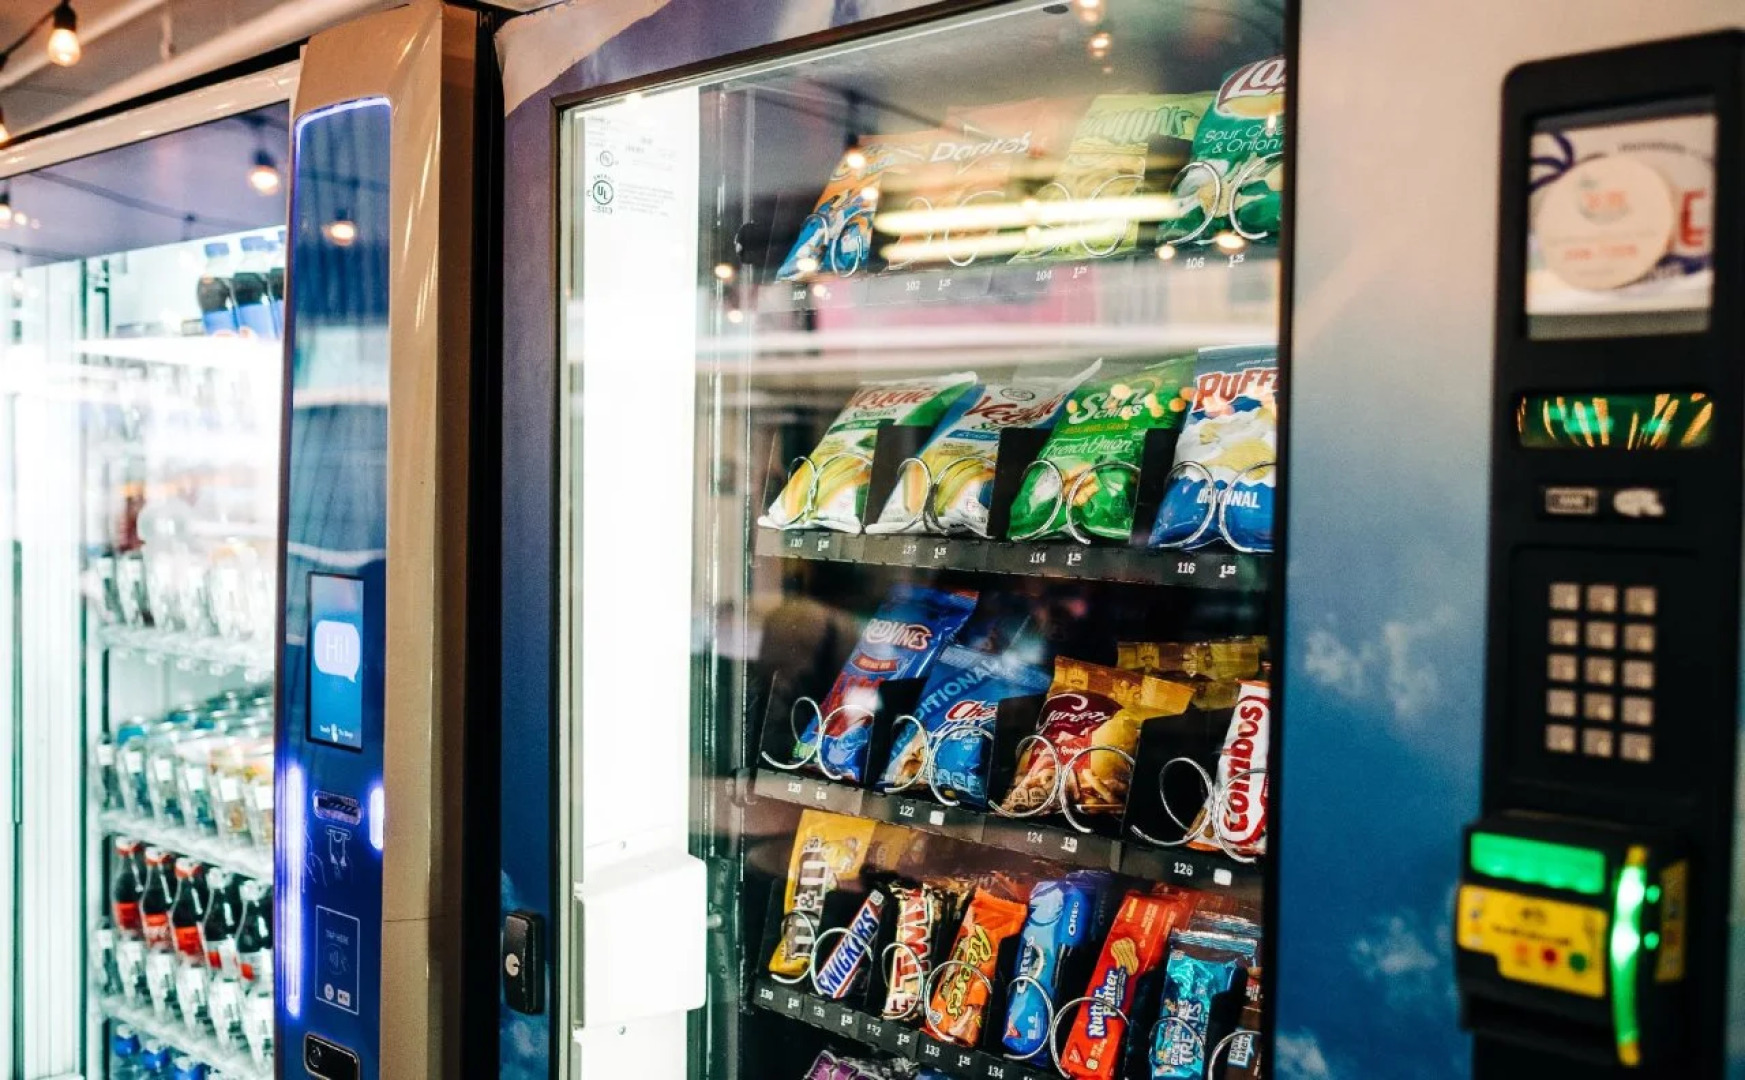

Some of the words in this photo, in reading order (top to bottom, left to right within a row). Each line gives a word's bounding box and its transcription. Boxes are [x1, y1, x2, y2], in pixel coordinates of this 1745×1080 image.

[1222, 58, 1284, 99] La
[1203, 129, 1242, 143] Sour
[1211, 141, 1223, 154] &
[1226, 137, 1278, 152] Onion
[1185, 257, 1205, 270] 106
[1193, 368, 1278, 410] RUFF
[1196, 488, 1261, 508] ORGINAL
[1029, 552, 1046, 563] 114
[1177, 562, 1196, 574] 116
[326, 632, 349, 662] Hi!
[945, 700, 997, 720] Che
[899, 805, 915, 818] 122
[1026, 831, 1043, 844] 124
[1173, 861, 1194, 877] 126
[1088, 989, 1104, 1036] Nuttr
[1180, 1002, 1202, 1066] TRETS
